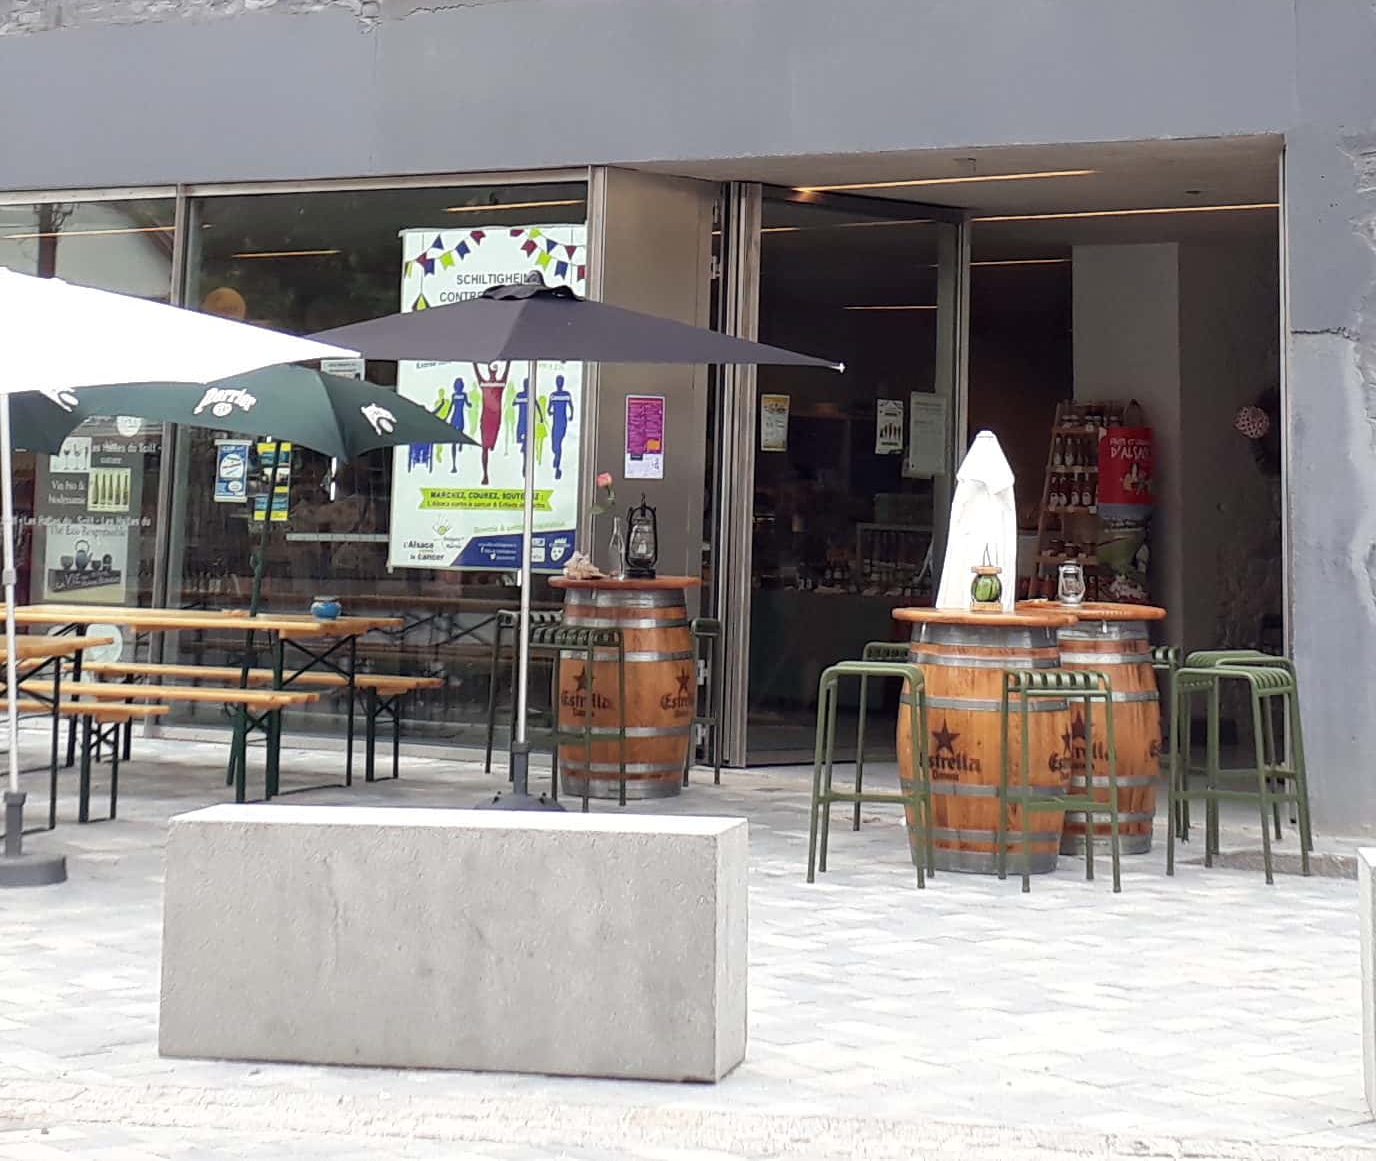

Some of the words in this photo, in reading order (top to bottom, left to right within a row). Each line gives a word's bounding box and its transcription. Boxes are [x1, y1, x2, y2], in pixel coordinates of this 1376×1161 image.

[456, 273, 530, 285] SCHILTIGHEI
[193, 387, 257, 415] Perrier
[1111, 445, 1150, 459] D'ALSA
[561, 691, 616, 710] Estrlla
[919, 751, 981, 773] strella
